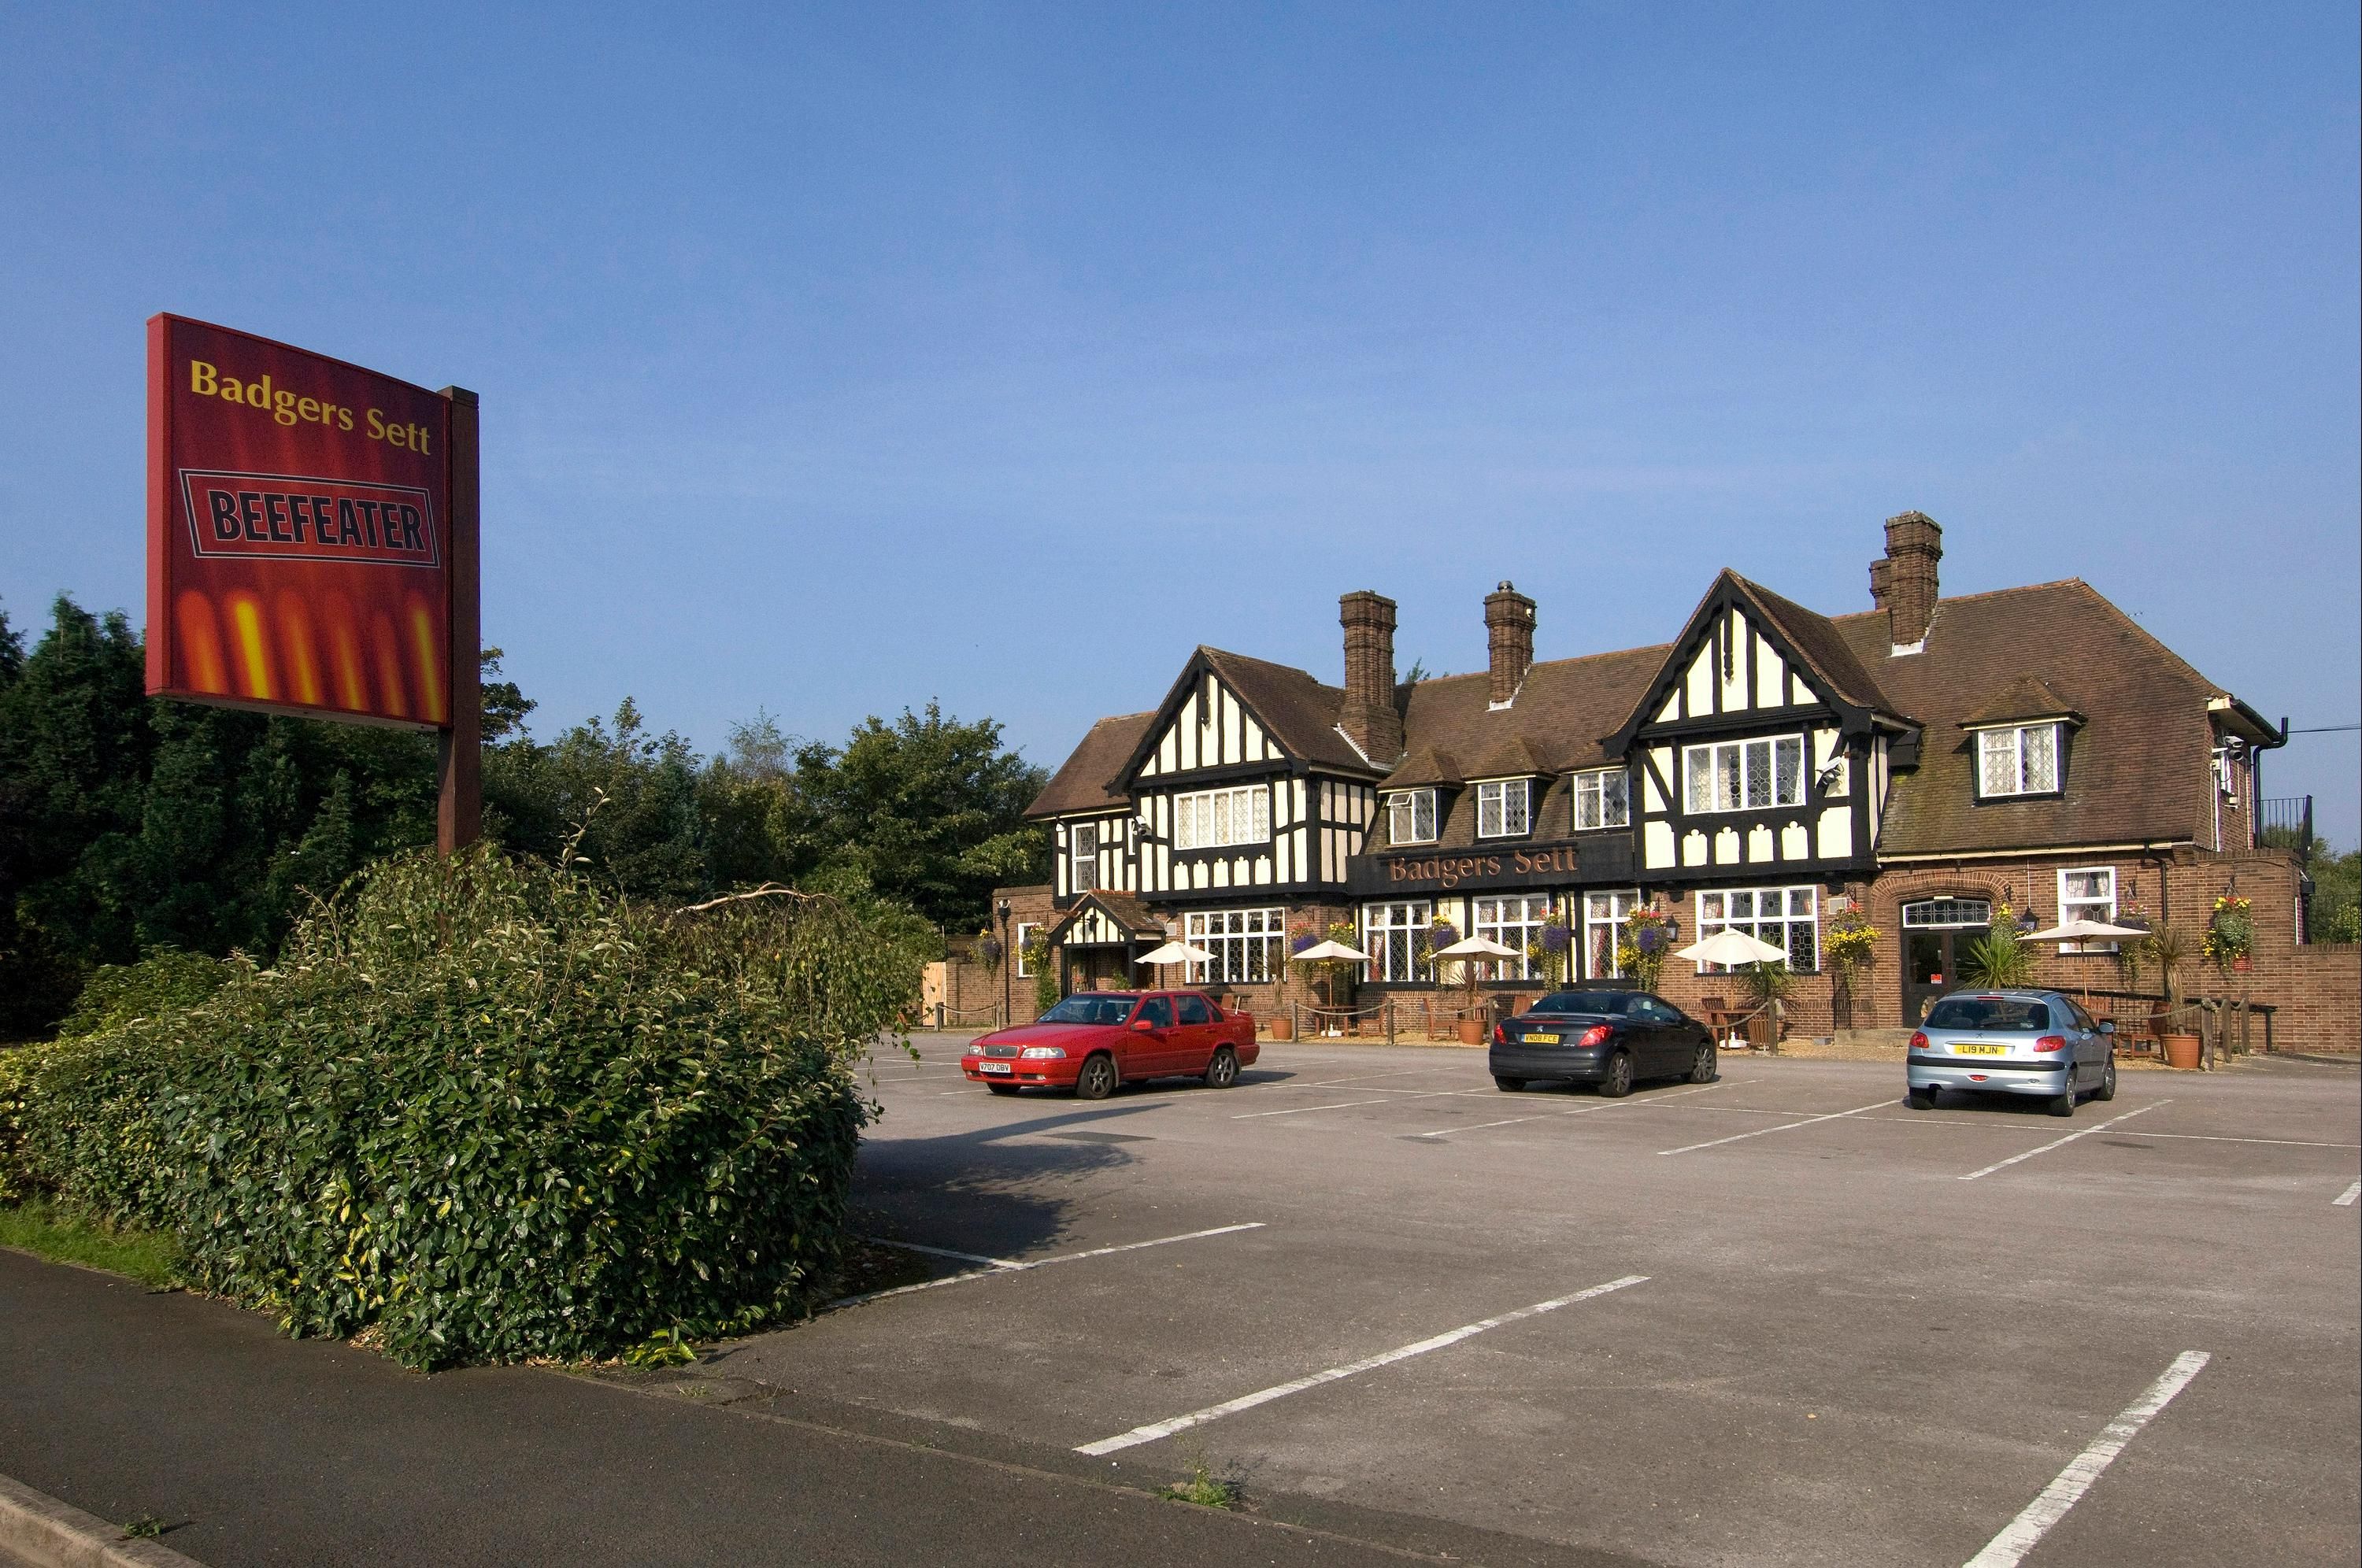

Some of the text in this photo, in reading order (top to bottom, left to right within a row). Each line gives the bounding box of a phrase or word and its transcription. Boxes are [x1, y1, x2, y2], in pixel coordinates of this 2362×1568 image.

[191, 359, 431, 456] Badgers Sett
[207, 488, 426, 552] BEEFEATER
[1389, 845, 1578, 888] Badgers Sett
